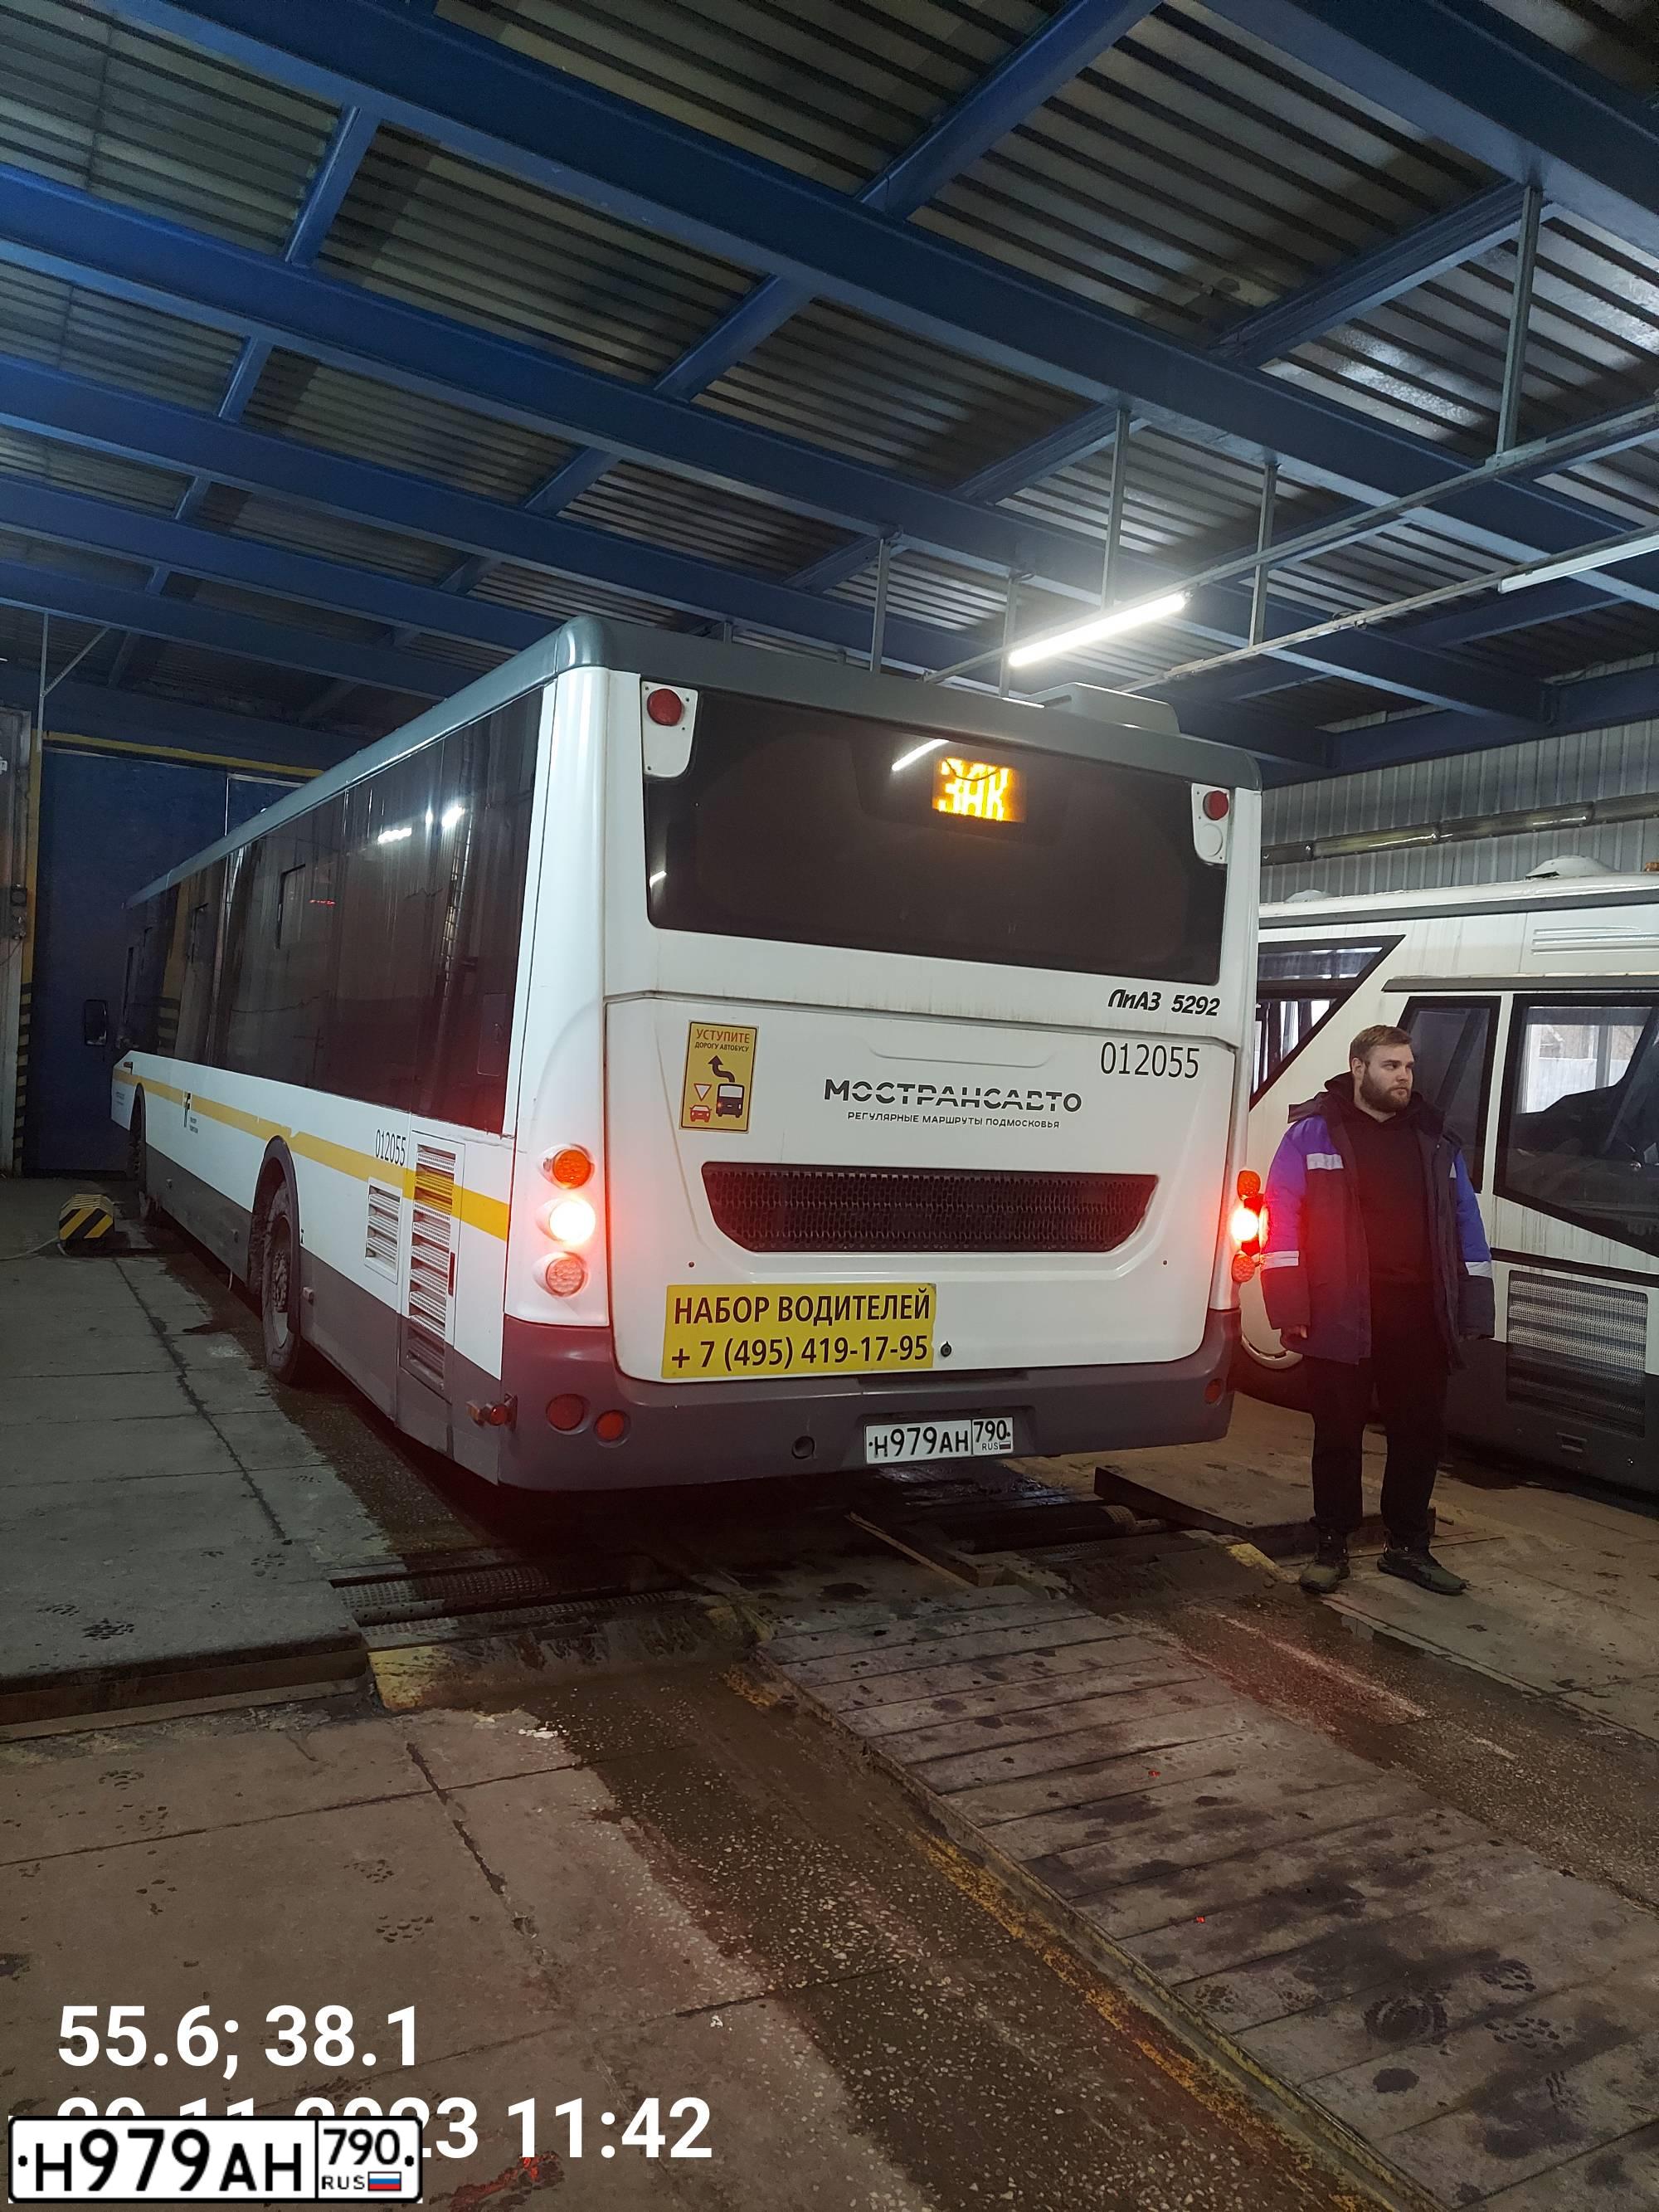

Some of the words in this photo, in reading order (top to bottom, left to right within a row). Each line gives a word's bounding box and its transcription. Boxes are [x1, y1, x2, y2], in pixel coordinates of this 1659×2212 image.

[1107, 988, 1161, 1011] ЛиАЗ
[1170, 995, 1221, 1016] 5292
[694, 1041, 719, 1050] ДОРОГУ
[719, 1044, 749, 1052] АВТОБУСУ
[696, 1028, 750, 1044] УСТУПИТЕ
[1101, 1041, 1200, 1079] 012055
[824, 1079, 1082, 1113] МОСТРАНСАВТО
[847, 1111, 920, 1123] РЕГУЛЯРНЫЕ
[922, 1115, 983, 1127] МАРШРУТЫ
[985, 1118, 1061, 1129] ПОДМОСКОВЬЯ
[375, 1128, 406, 1167] 012055
[674, 1296, 770, 1324] НАБОР
[777, 1287, 930, 1327] ВОДИТЕЛЕЙ
[671, 1347, 691, 1369] +
[700, 1340, 715, 1368] 7
[723, 1336, 795, 1372] (495)
[801, 1334, 928, 1364] 419-17-95
[873, 1425, 969, 1459] Н979АН
[973, 1420, 1007, 1443] 790
[981, 1442, 999, 1451] RUS
